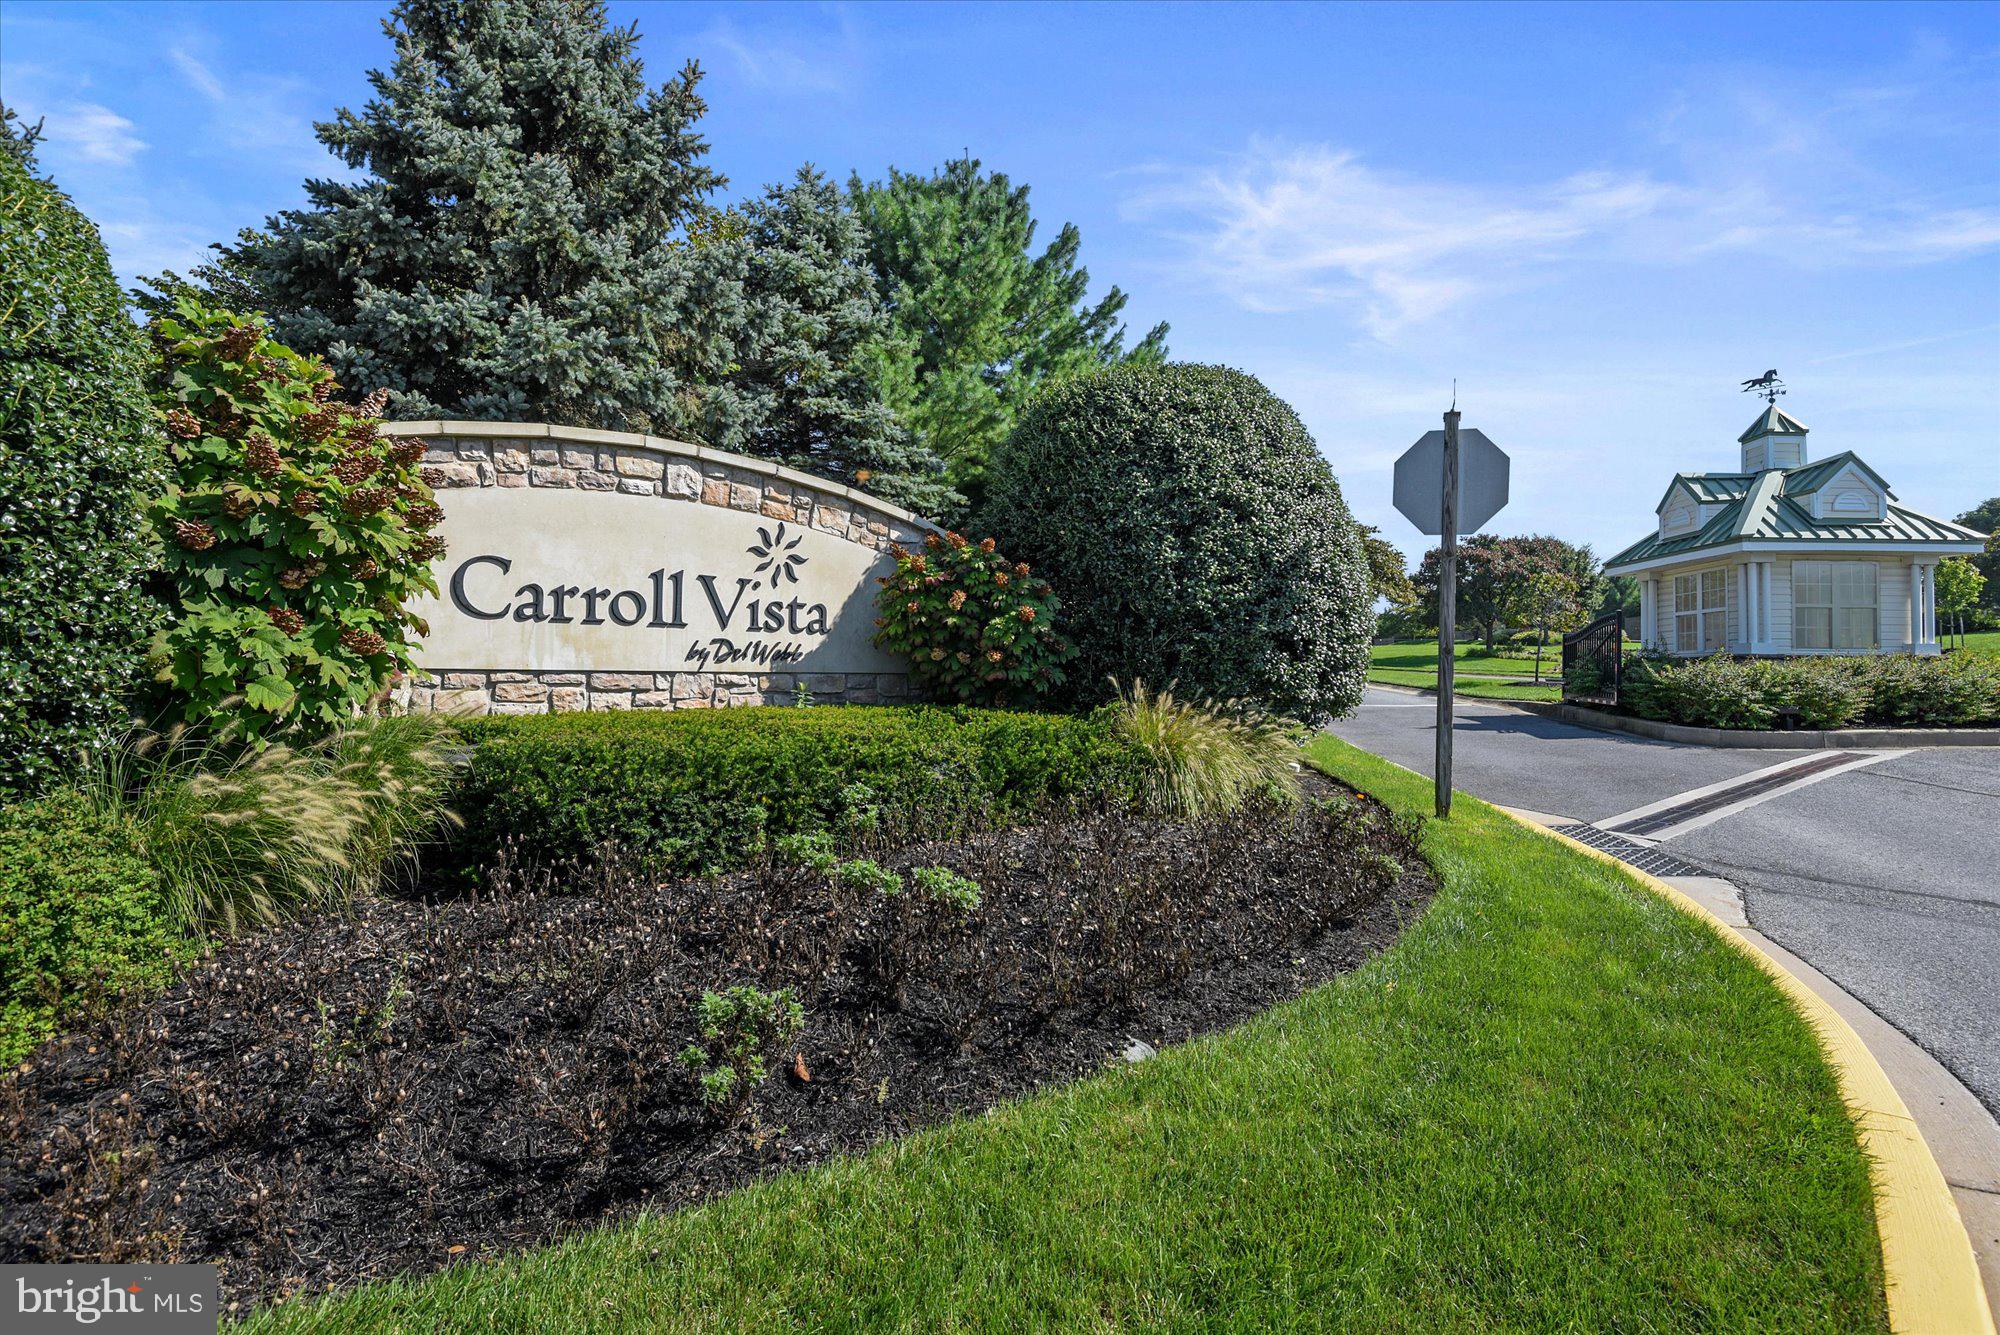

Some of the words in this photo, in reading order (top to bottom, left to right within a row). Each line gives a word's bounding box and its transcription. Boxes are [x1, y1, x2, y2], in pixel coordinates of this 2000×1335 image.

[449, 554, 689, 629] Carroll
[697, 573, 832, 636] Vista
[684, 639, 711, 672] by
[709, 637, 753, 664] Del
[749, 640, 804, 666] Webb
